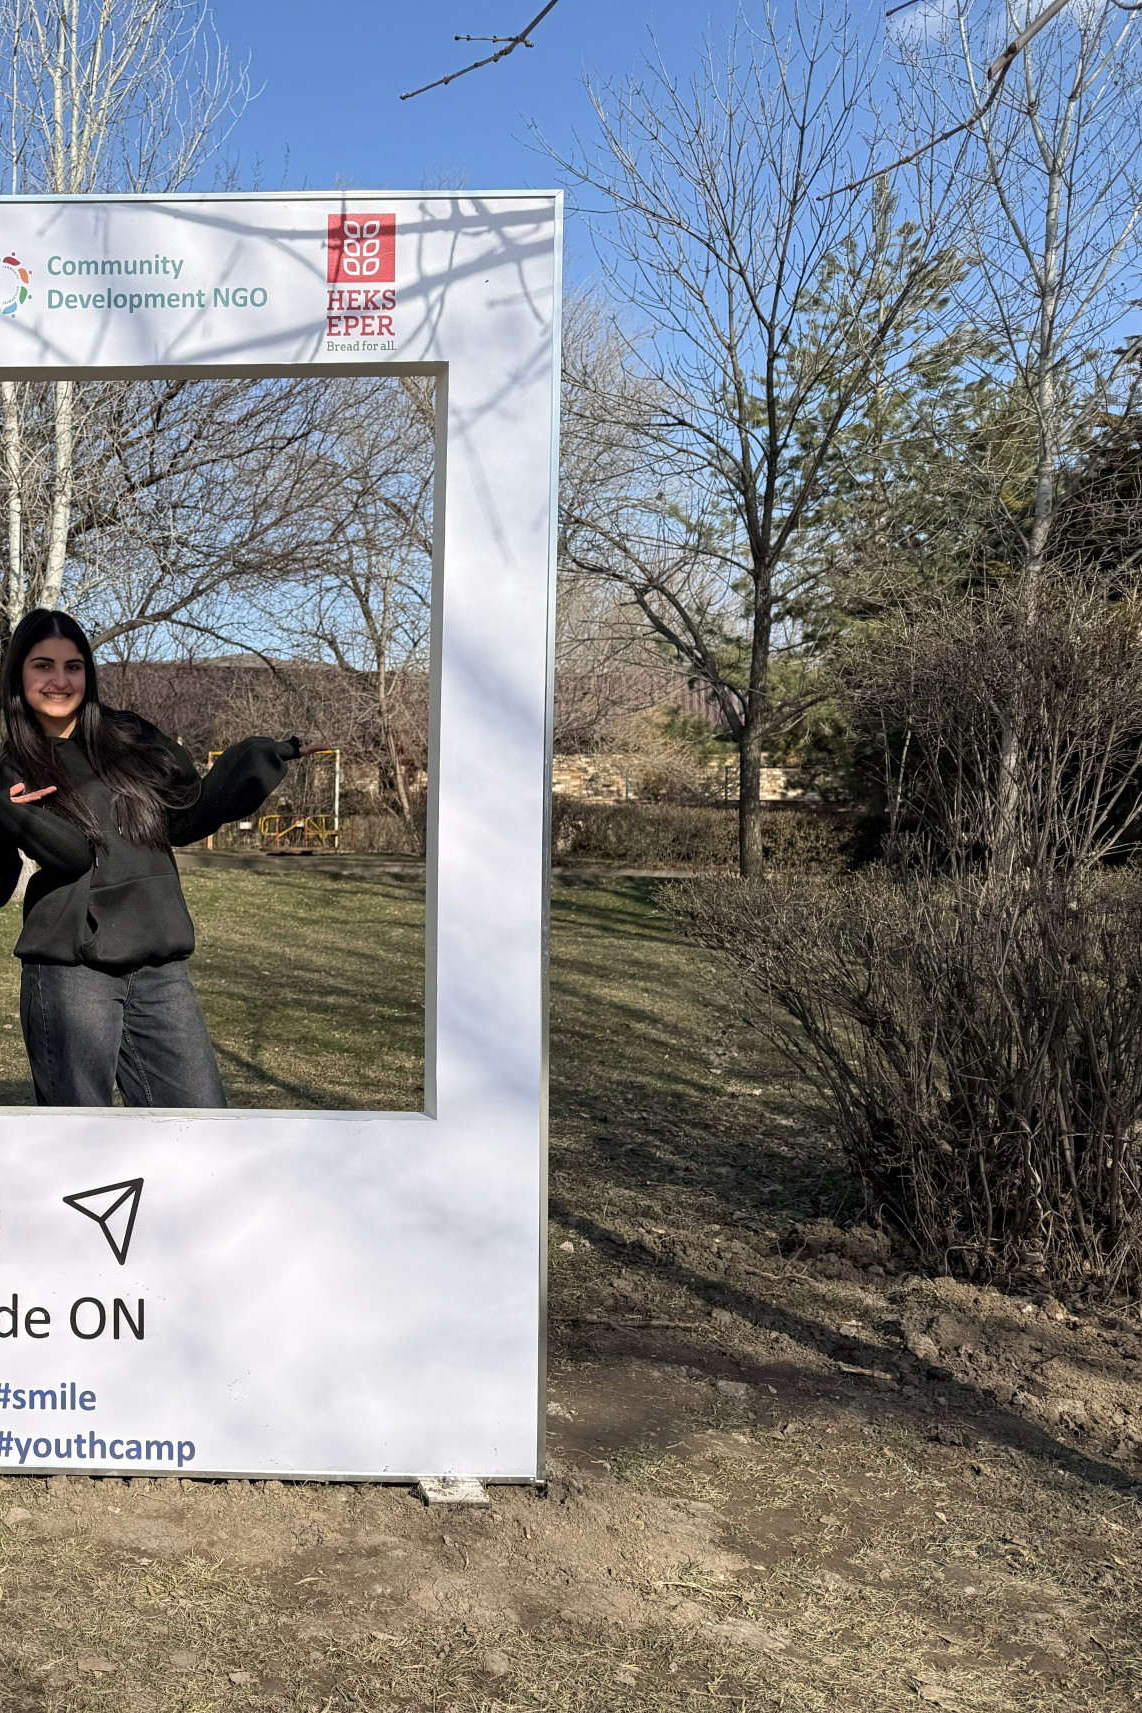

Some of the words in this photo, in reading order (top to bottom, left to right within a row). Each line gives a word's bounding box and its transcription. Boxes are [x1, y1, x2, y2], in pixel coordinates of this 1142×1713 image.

[47, 254, 184, 279] Community
[47, 287, 206, 314] Development
[212, 287, 268, 308] NGO
[327, 289, 397, 312] HEKS
[327, 315, 396, 337] EPER
[327, 341, 360, 352] Bread
[361, 340, 377, 352] for
[379, 340, 397, 352] all.
[69, 1296, 146, 1341] ON
